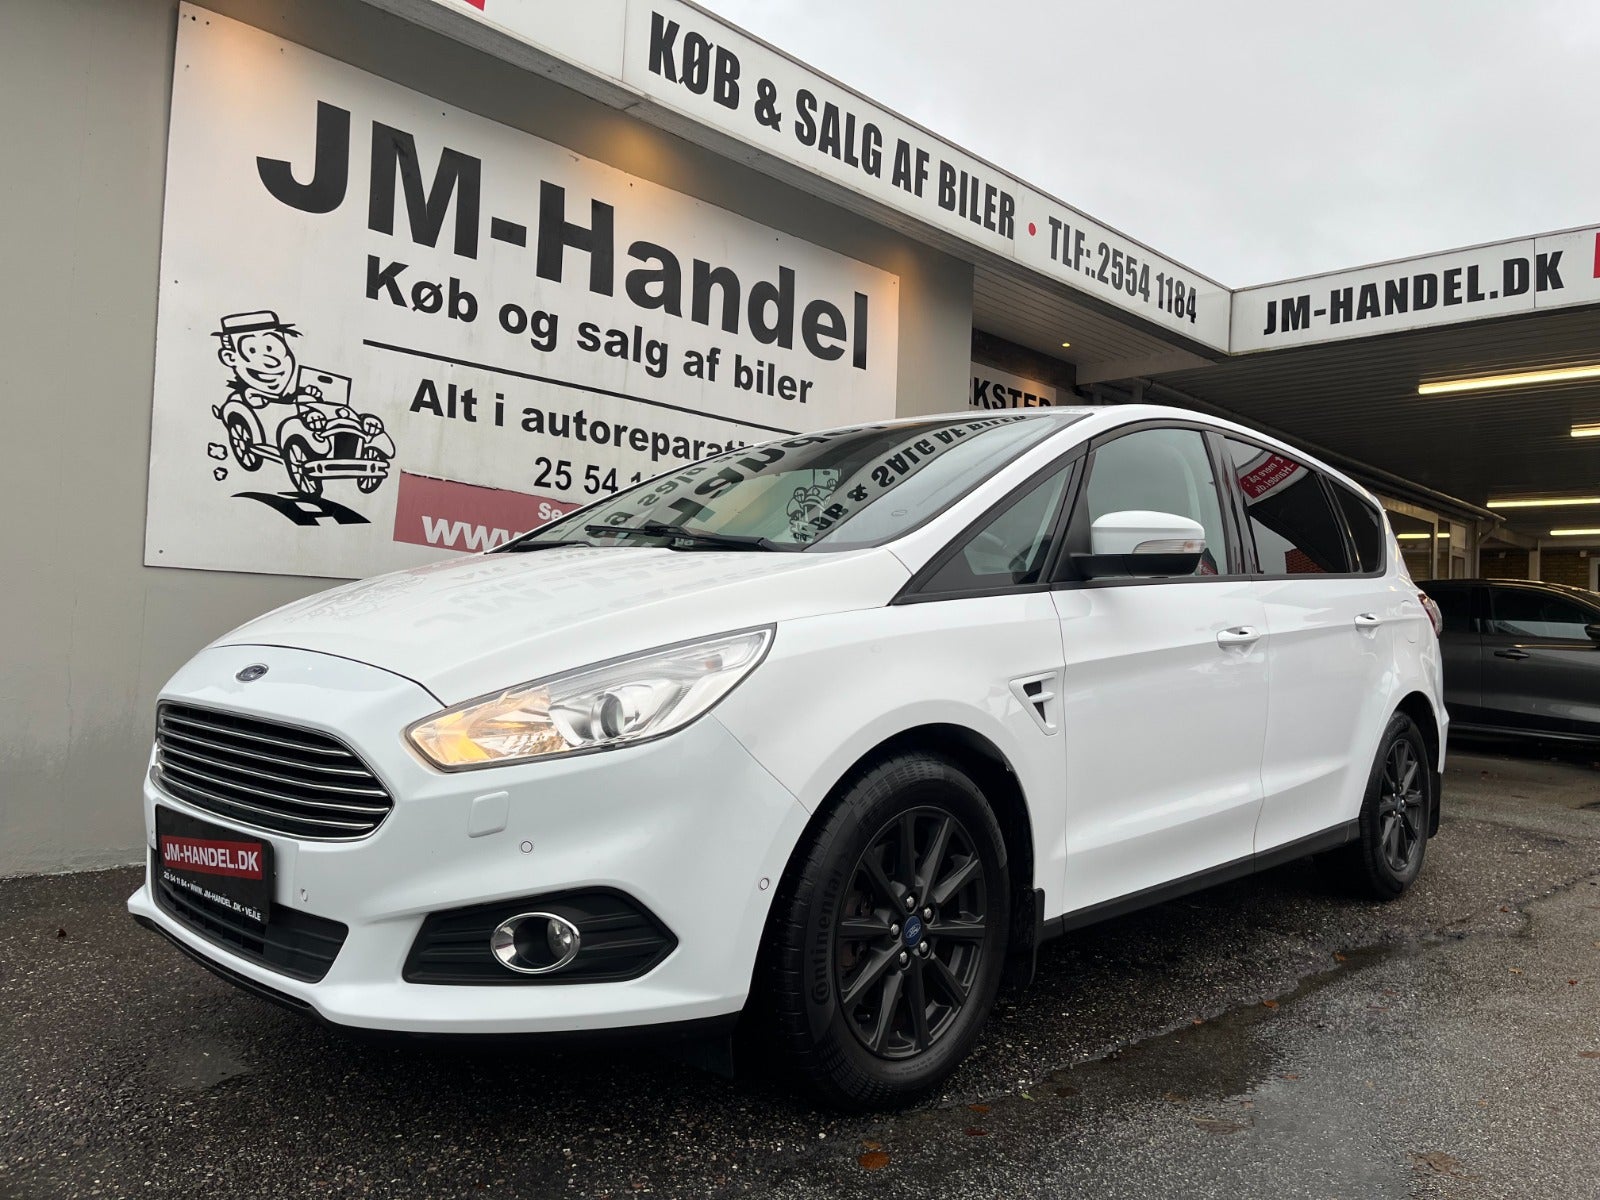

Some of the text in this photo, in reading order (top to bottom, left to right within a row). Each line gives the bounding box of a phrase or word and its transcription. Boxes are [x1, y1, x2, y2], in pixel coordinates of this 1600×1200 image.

[649, 11, 741, 110] KØB
[755, 78, 782, 132] &
[795, 88, 883, 178] SALG
[892, 138, 930, 198] AF
[938, 160, 1016, 240] BILER
[1156, 272, 1197, 324] 1184
[256, 100, 868, 370] JM-Handel
[1263, 250, 1565, 336] JM-HANDEL.DK
[366, 254, 814, 405] Køb og salg af biler
[409, 378, 478, 423] Alt
[495, 393, 505, 427] i
[969, 376, 1052, 410] KSTE
[534, 456, 572, 491] 25
[583, 464, 619, 494] 54
[421, 515, 525, 553] ww
[165, 843, 259, 872] JM-HANDEL.DK
[244, 905, 262, 921] VEJLE
